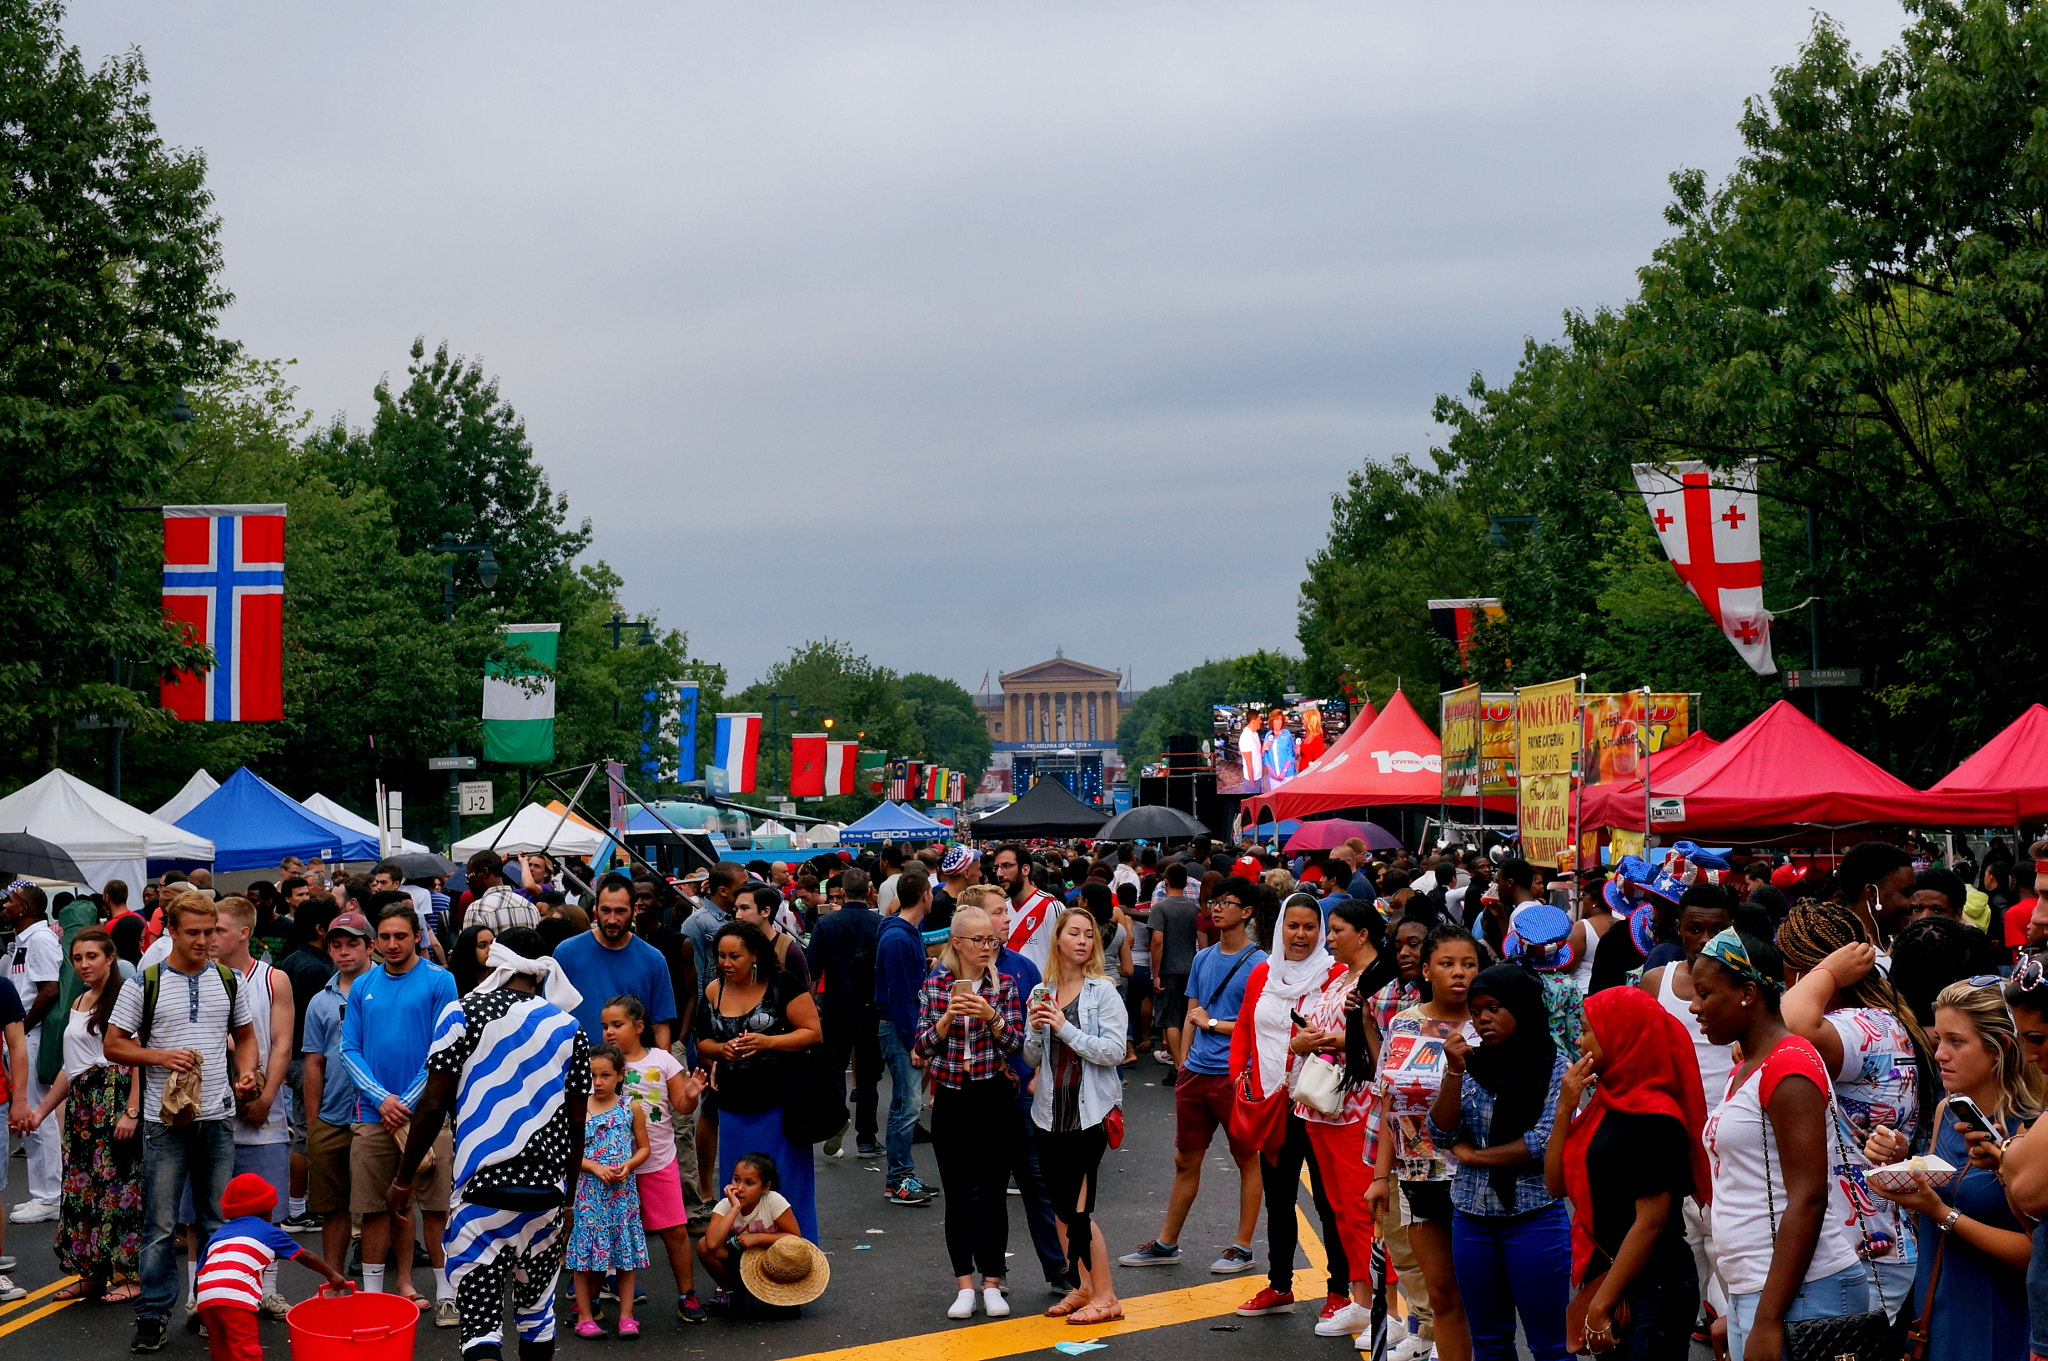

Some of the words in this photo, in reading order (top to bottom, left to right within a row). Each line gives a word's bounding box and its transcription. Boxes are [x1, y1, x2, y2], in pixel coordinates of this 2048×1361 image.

[1811, 670, 1846, 678] GEORGIA
[469, 796, 486, 811] J-2
[1651, 807, 1680, 816] Furmax
[871, 830, 910, 840] GEICO
[1897, 1237, 1905, 1260] LOVE
